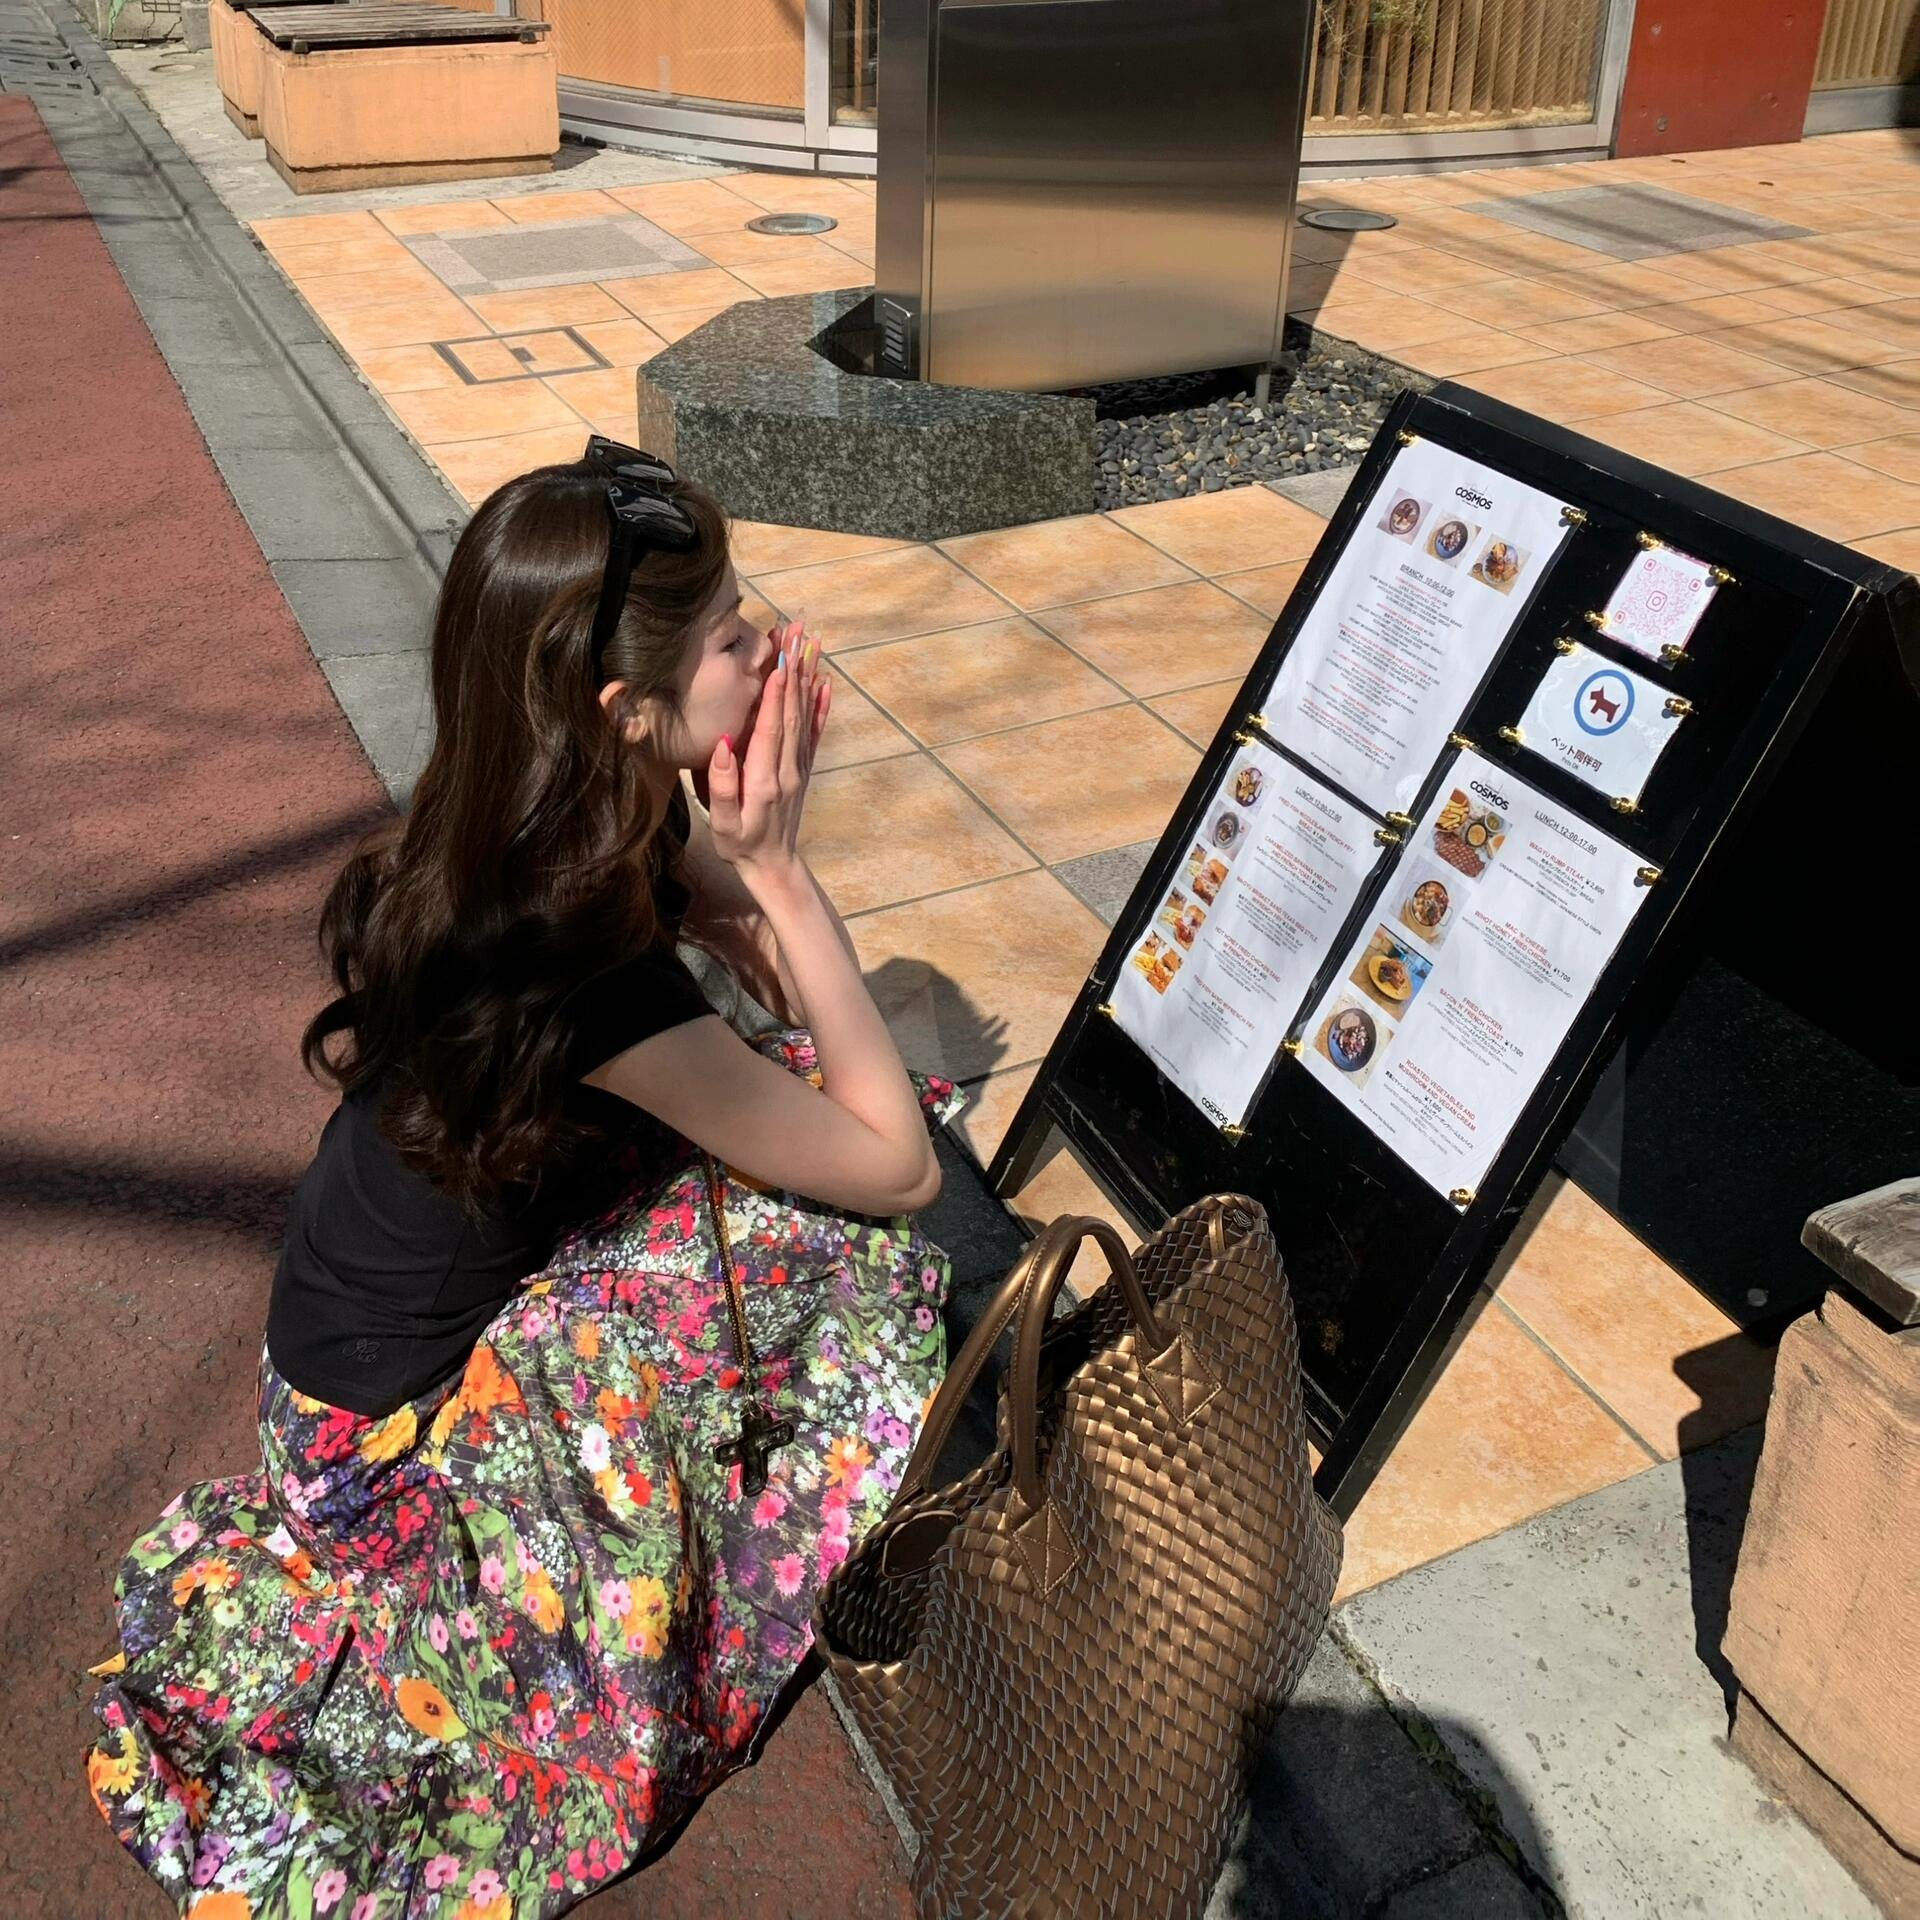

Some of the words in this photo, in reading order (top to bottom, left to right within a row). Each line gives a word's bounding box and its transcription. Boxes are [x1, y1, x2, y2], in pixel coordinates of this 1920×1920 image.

[1455, 487, 1493, 510] COSMOS
[1551, 737, 1602, 772] ペット同伴可
[1294, 786, 1314, 803] LUNCH
[1468, 779, 1511, 811] COSMOS
[1533, 809, 1560, 831] LUNCH
[1558, 825, 1598, 856] 12:00-17:00
[1528, 841, 1550, 859] WAGYU
[1548, 854, 1566, 869] RUMP
[1564, 865, 1585, 882] STEAK
[1491, 922, 1512, 940] HONEY
[1510, 936, 1527, 951] FRIED
[1526, 947, 1552, 969] CHICKEN
[1504, 921, 1518, 934] MAC
[1524, 935, 1548, 955] CHEESE
[1438, 987, 1458, 1005] BACON
[1463, 1006, 1485, 1028] FRENCH
[1484, 1024, 1504, 1042] TOAST
[1462, 996, 1479, 1012] FRIED
[1477, 1008, 1503, 1032] CHICKEN
[1397, 1061, 1428, 1091] MUSHROOM
[1426, 1086, 1439, 1100] AND
[1438, 1096, 1457, 1116] VEGAN
[1456, 1111, 1477, 1133] CREAM
[1405, 1058, 1430, 1083] ROASTED
[1429, 1078, 1464, 1112] VEGETABLES
[1462, 1107, 1476, 1121] AND
[1201, 1097, 1229, 1125] COSMOS
